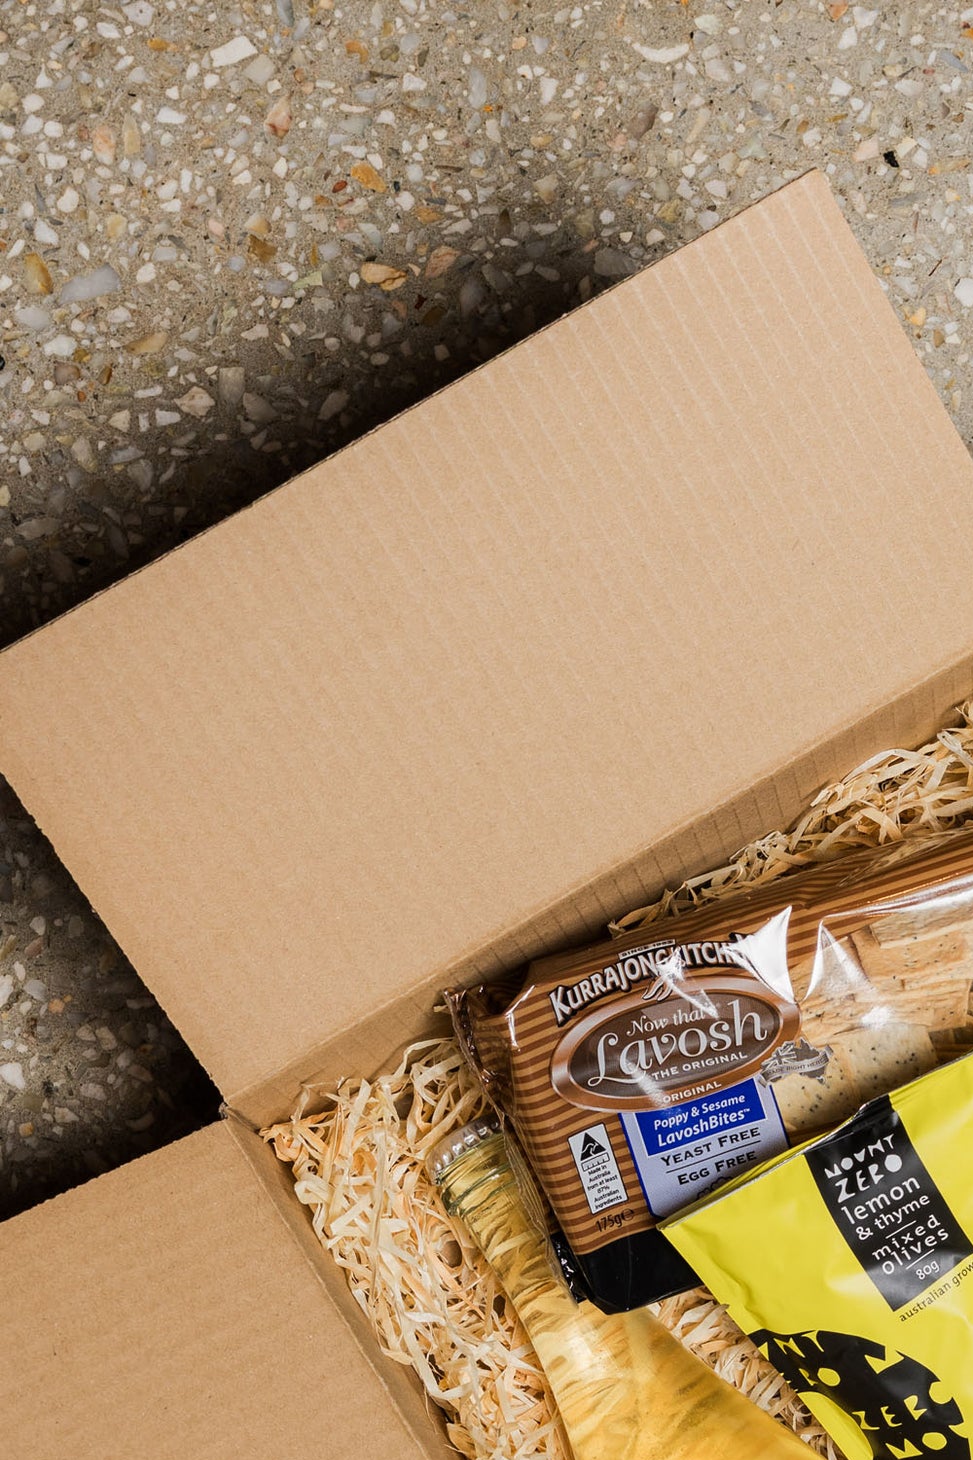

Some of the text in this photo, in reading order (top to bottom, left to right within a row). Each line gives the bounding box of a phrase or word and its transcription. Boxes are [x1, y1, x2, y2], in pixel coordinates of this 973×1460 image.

[627, 1007, 707, 1037] Now that
[588, 1000, 767, 1087] Lavosh
[652, 1052, 748, 1081] THE ORIGINAL
[654, 1094, 746, 1131] Poppy & Sesame
[662, 1081, 722, 1104] ORIGINAL
[660, 1127, 761, 1167] YEAST FREE
[824, 1133, 895, 1178] MOUNT
[678, 1151, 758, 1185] EGG FREE
[835, 1153, 903, 1203] ZERO
[841, 1176, 921, 1225] lemon
[855, 1193, 931, 1241] & thyme
[872, 1214, 941, 1261] mixed
[882, 1228, 949, 1275] olives
[915, 1260, 941, 1280] 80g
[899, 1282, 952, 1322] australian
